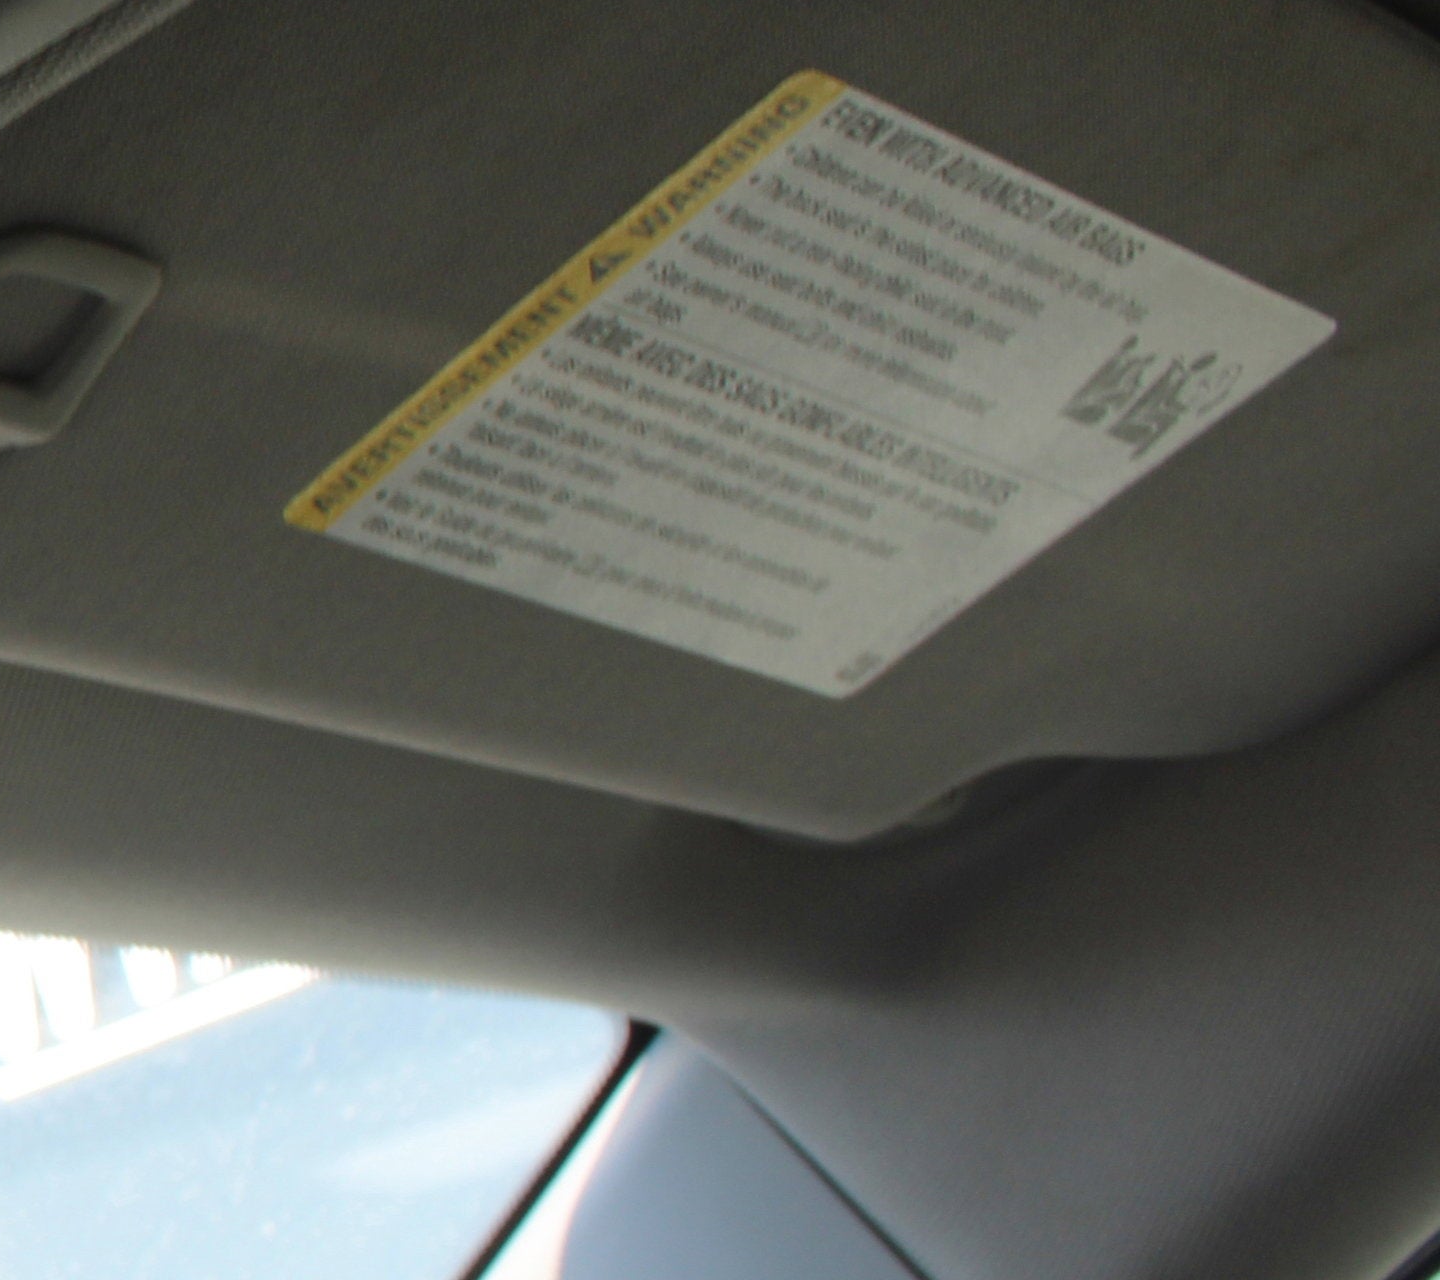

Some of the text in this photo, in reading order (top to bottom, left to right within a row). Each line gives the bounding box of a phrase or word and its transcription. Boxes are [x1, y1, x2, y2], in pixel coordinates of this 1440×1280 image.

[628, 94, 811, 240] WARNING
[824, 100, 1146, 264] EVEN WITH ADVANCED AIR BAGS
